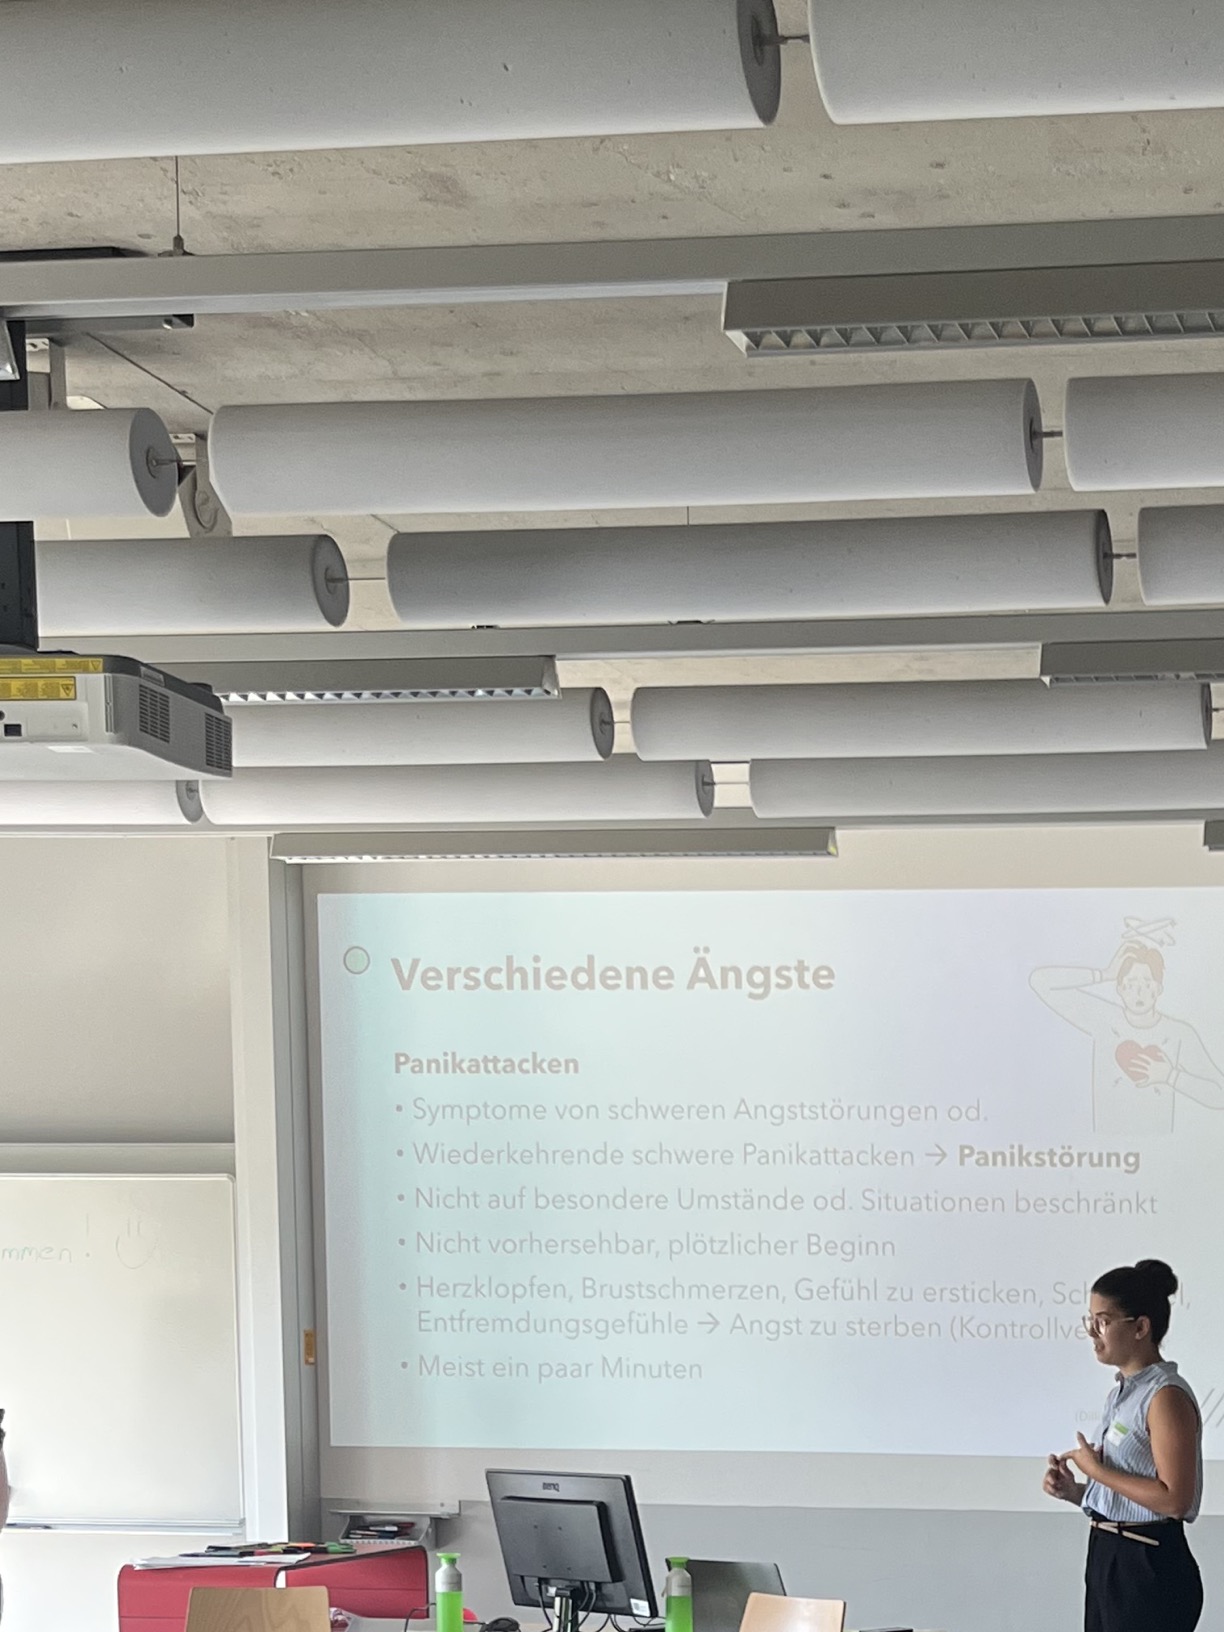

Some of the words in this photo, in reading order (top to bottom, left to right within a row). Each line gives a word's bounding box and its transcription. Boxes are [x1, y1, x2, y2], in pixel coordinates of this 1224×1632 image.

[391, 955, 675, 992] Verschiedene
[687, 946, 835, 1000] Ängste
[394, 1052, 579, 1075] Panikattacken
[412, 1098, 547, 1127] Symptome
[555, 1104, 599, 1120] von
[608, 1099, 726, 1121] schweren
[733, 1098, 938, 1127] Angststörungen
[947, 1101, 989, 1122] od.
[412, 1143, 624, 1166] Wiederkehrende
[633, 1144, 734, 1166] schwere
[742, 1144, 914, 1167] Panikattacken
[958, 1144, 1141, 1174] Panikstörung
[415, 1188, 480, 1211] Nicht
[488, 1187, 526, 1211] auf
[535, 1188, 669, 1211] besondere
[677, 1188, 804, 1212] Umstände
[813, 1189, 854, 1213] od.
[861, 1189, 1005, 1214] Situationen
[1014, 1191, 1158, 1215] beschränkt
[416, 1232, 481, 1255] Nicht
[488, 1233, 659, 1259] vorhersehbar,
[668, 1233, 799, 1262] plötzlicher
[807, 1234, 896, 1262] Beginn
[417, 1276, 573, 1303] Herzklopfen,
[582, 1277, 786, 1303] Brustschmerzen,
[795, 1279, 879, 1302] Gefühl
[887, 1286, 914, 1303] zu
[922, 1280, 1044, 1306] ersticken,
[417, 1312, 688, 1339] Entfremdungsgefühle
[730, 1313, 803, 1341] Angst
[810, 1320, 837, 1338] zu
[845, 1315, 941, 1339] sterben
[950, 1315, 1088, 1342] (Kontrollve
[418, 1356, 485, 1379] Meist
[492, 1356, 529, 1379] ein
[537, 1361, 593, 1385] paar
[601, 1357, 703, 1381] Minuten
